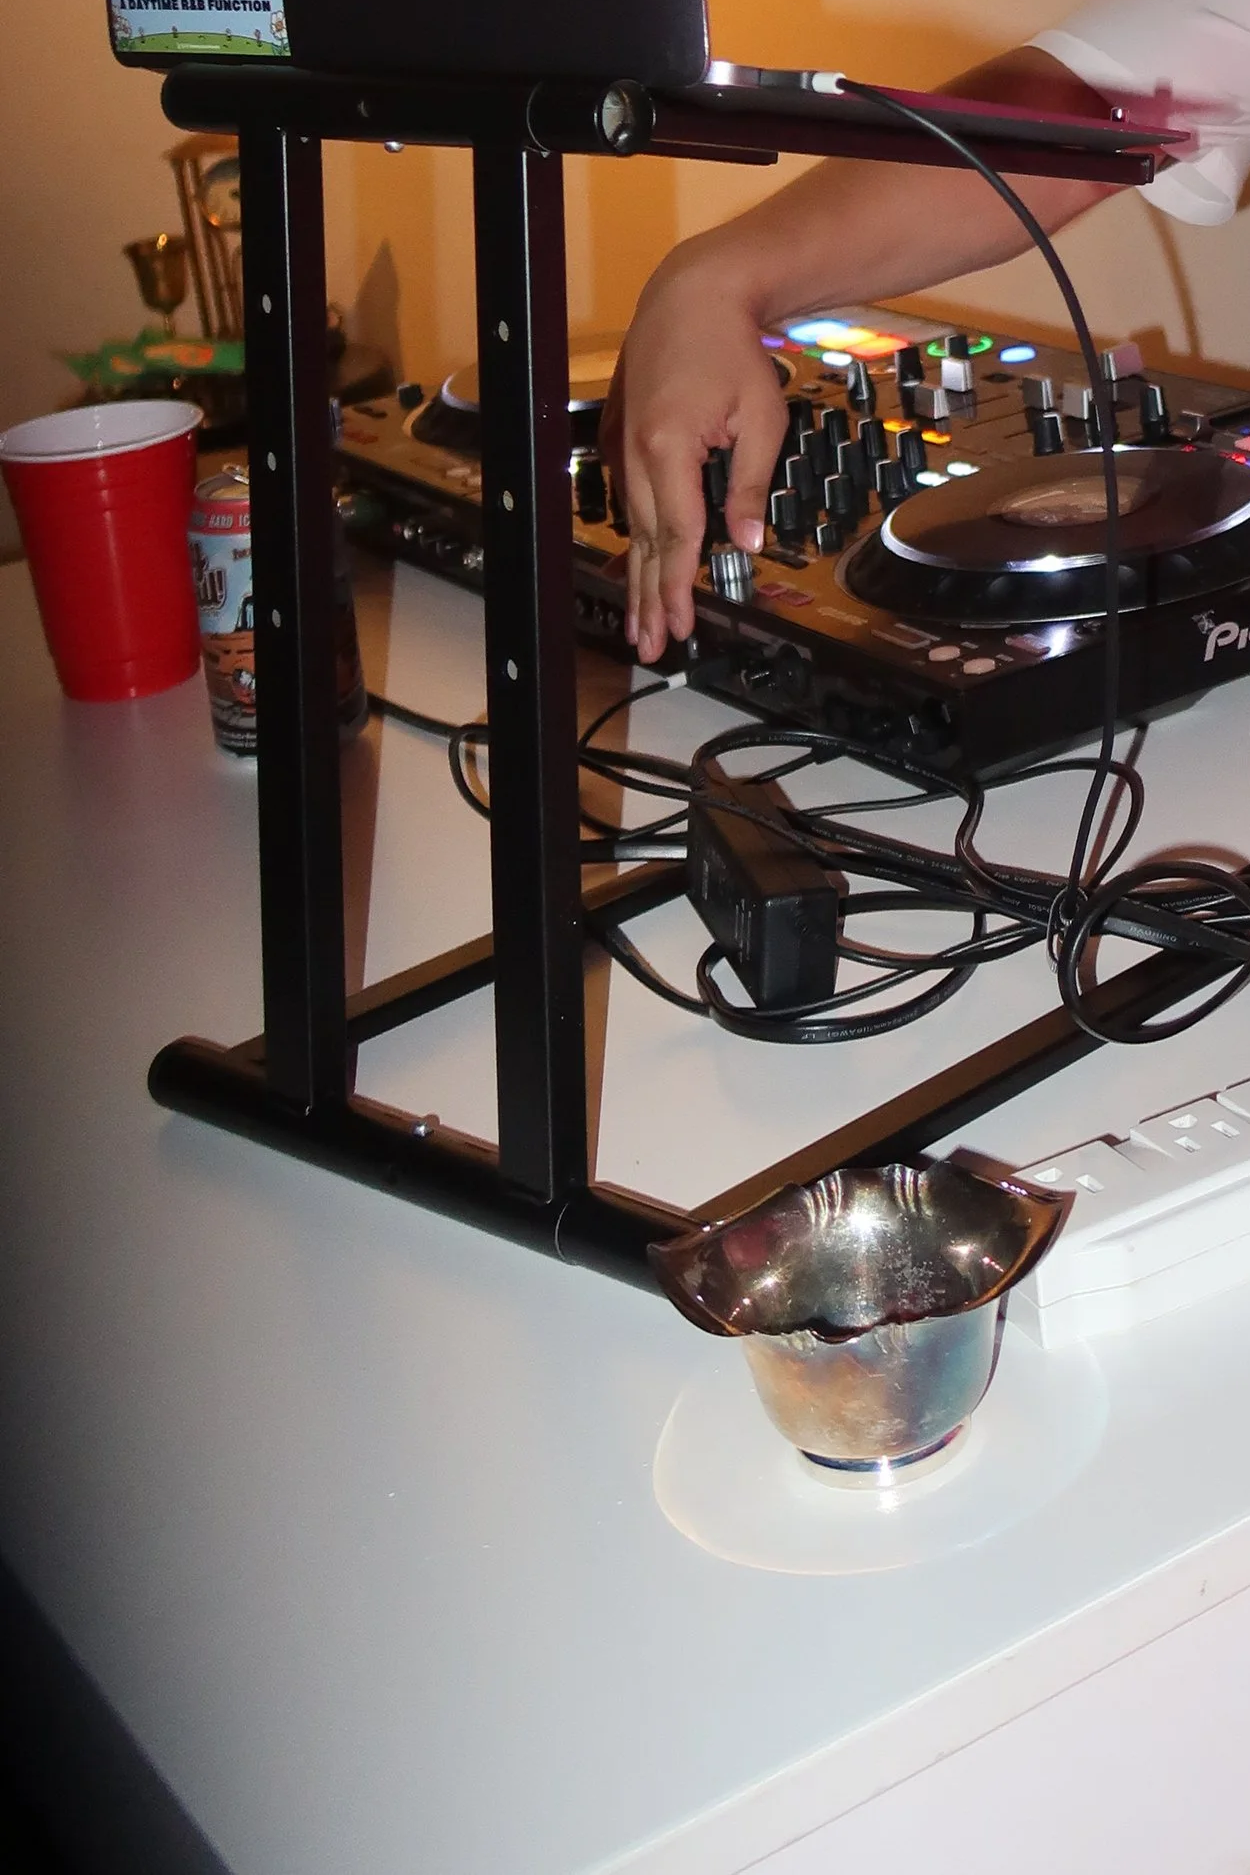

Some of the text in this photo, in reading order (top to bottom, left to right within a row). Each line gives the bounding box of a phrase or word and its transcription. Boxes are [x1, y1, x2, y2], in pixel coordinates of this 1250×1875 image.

[120, 0, 272, 12] A DAYTIME R&B FUNCTION
